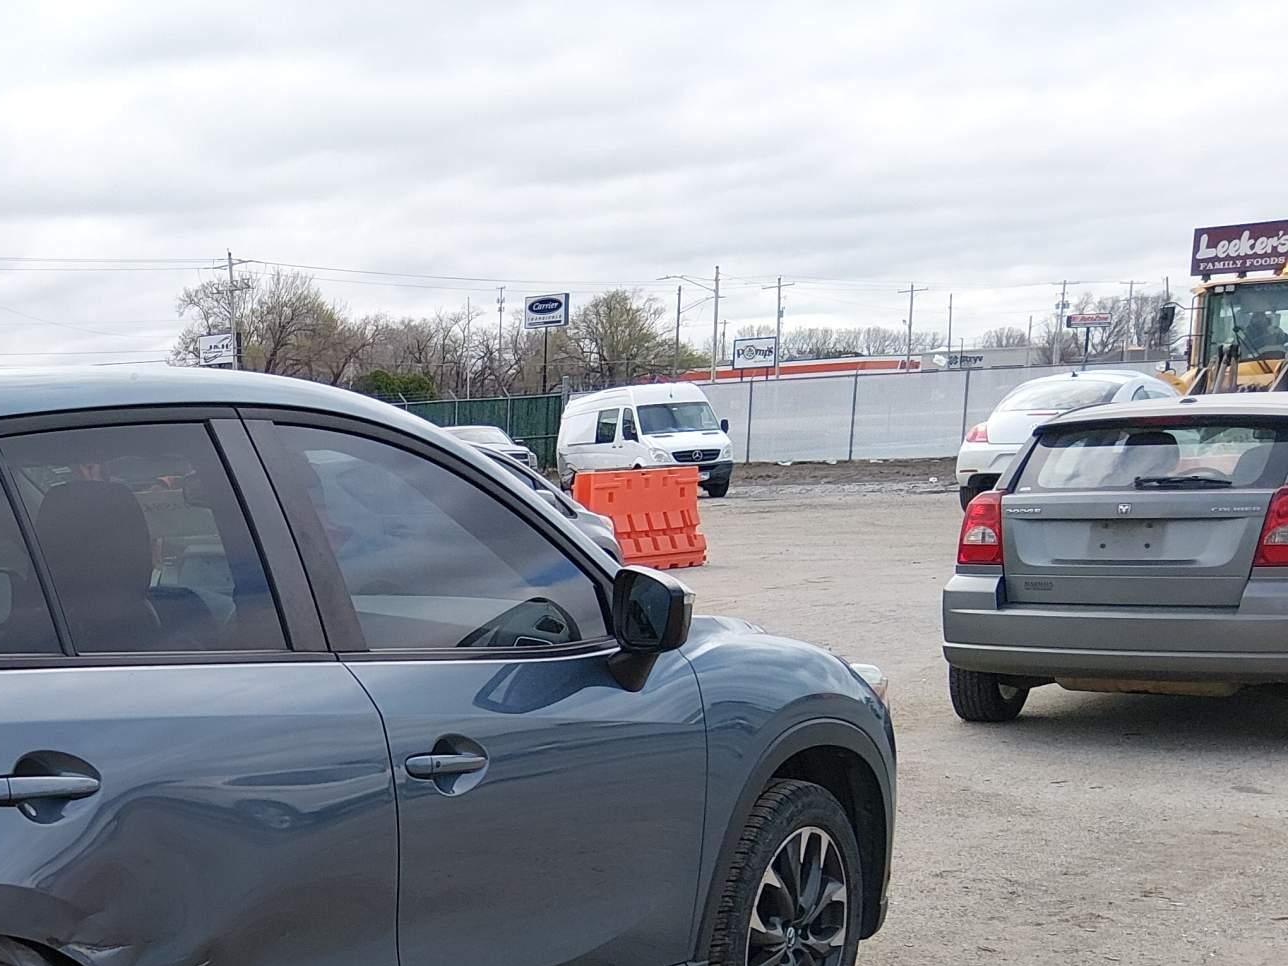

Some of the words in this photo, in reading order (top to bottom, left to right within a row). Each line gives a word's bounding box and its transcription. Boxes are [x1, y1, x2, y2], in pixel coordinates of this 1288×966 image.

[1196, 231, 1288, 259] Leeker's
[1200, 260, 1242, 271] FAMILY
[1246, 257, 1285, 267] FOODS
[532, 302, 559, 311] Carrier
